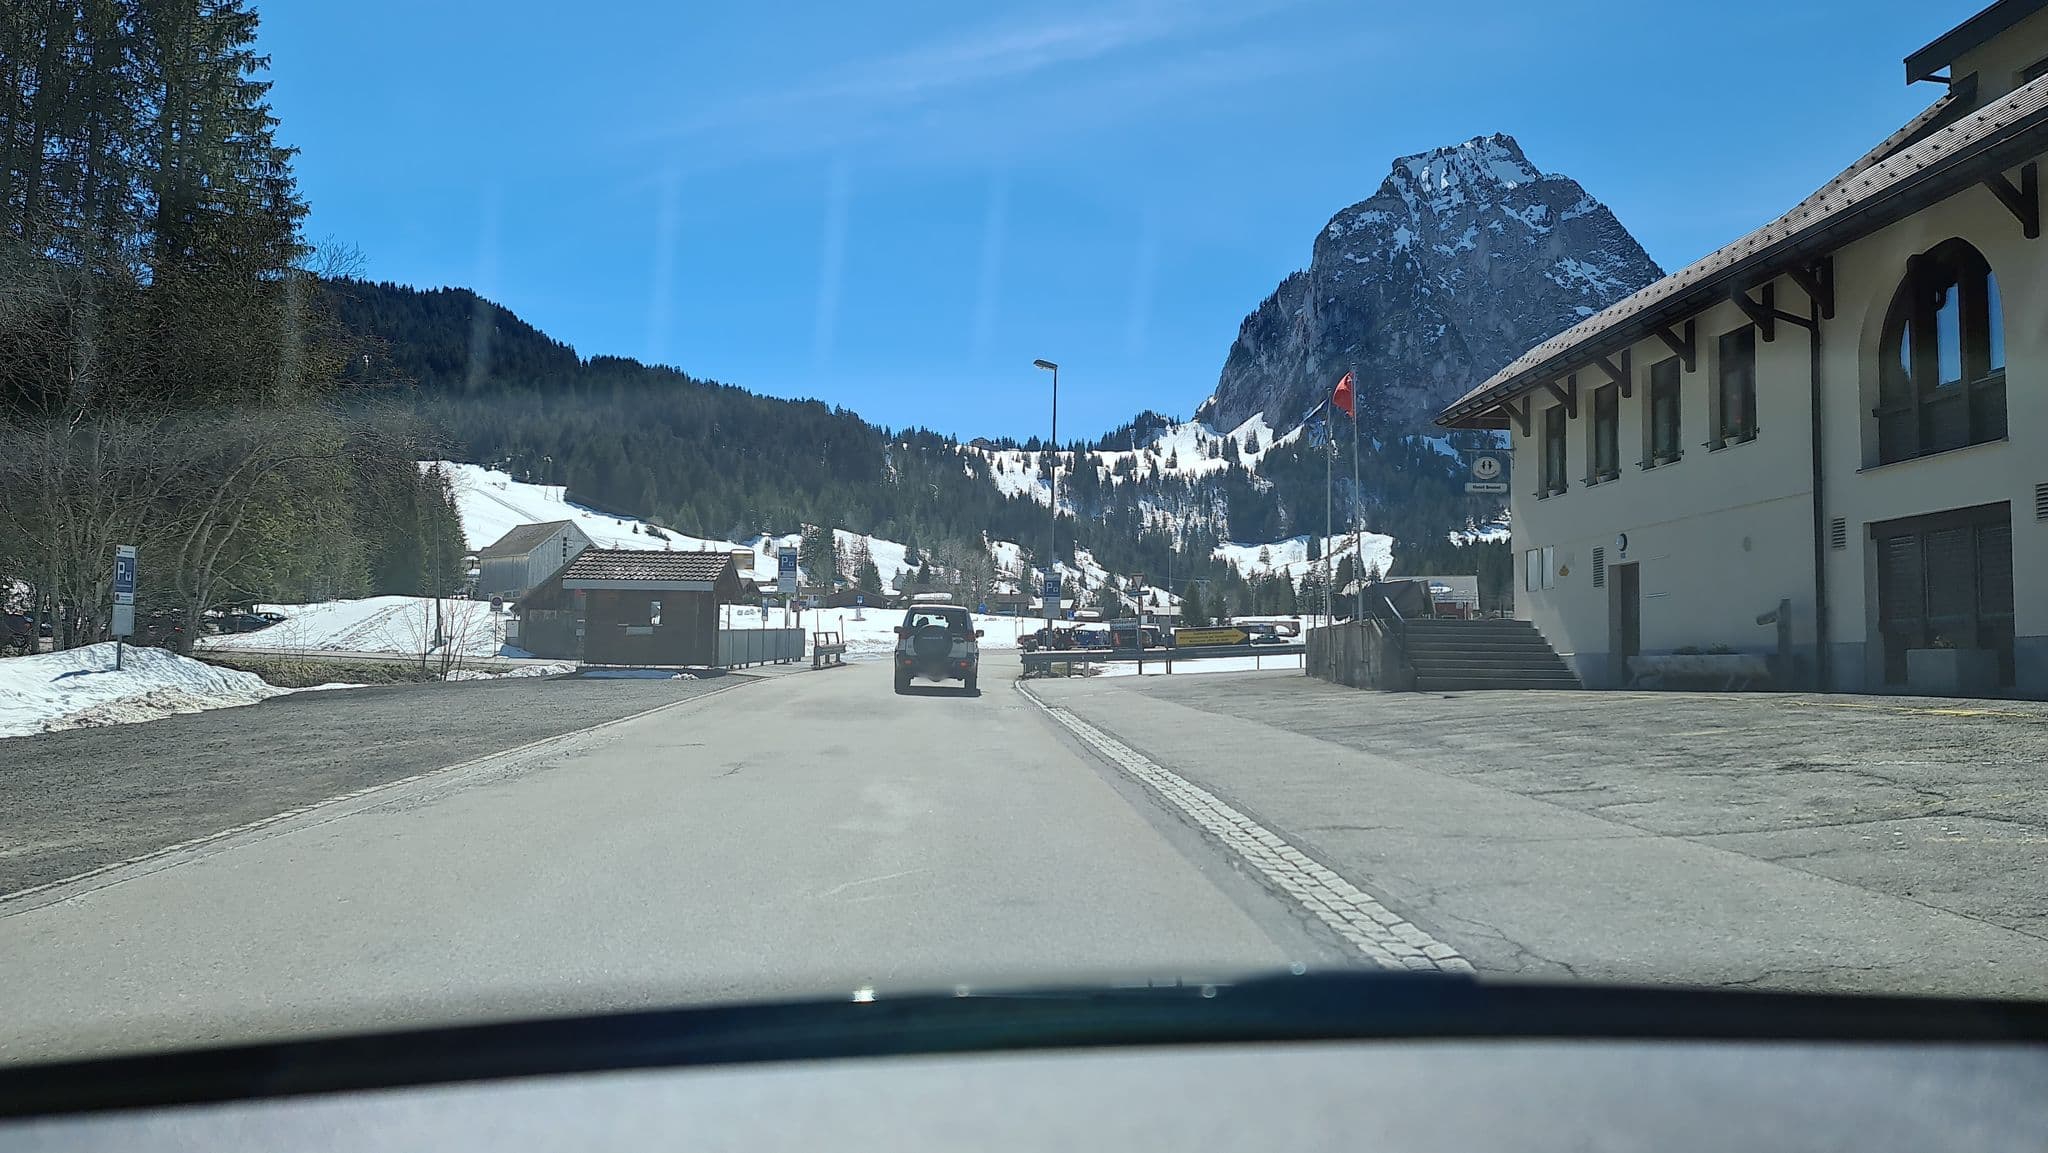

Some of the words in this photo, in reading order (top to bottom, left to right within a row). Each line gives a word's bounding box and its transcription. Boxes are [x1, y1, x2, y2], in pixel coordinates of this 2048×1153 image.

[781, 556, 789, 567] P
[117, 561, 126, 581] P
[1046, 582, 1053, 593] P
